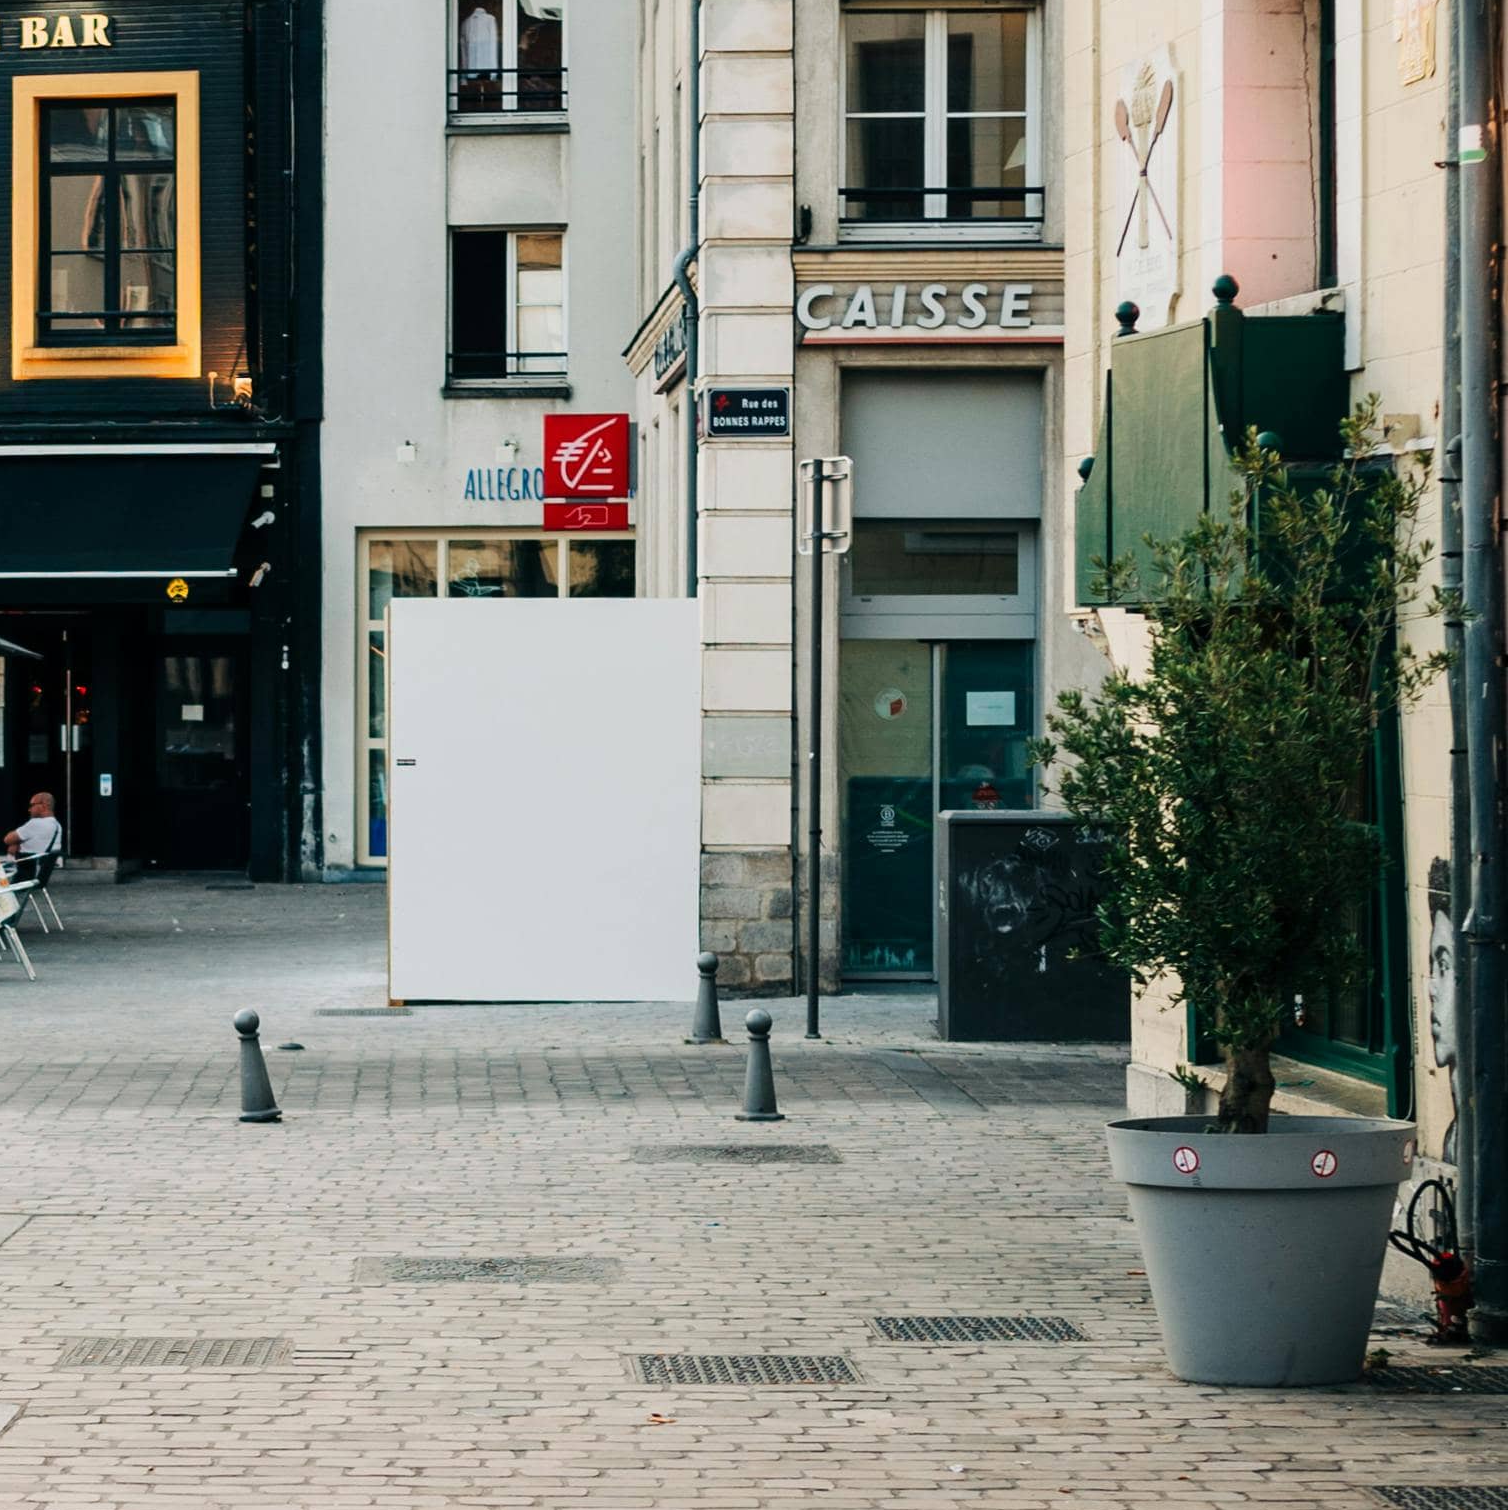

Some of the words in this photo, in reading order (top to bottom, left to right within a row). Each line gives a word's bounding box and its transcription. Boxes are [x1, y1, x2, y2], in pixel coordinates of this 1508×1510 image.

[19, 13, 112, 49] BAR
[796, 283, 1034, 330] CAISSE
[741, 398, 759, 409] Rue
[761, 398, 778, 409] des
[713, 416, 749, 427] BONNES
[752, 416, 786, 427] RAPPES
